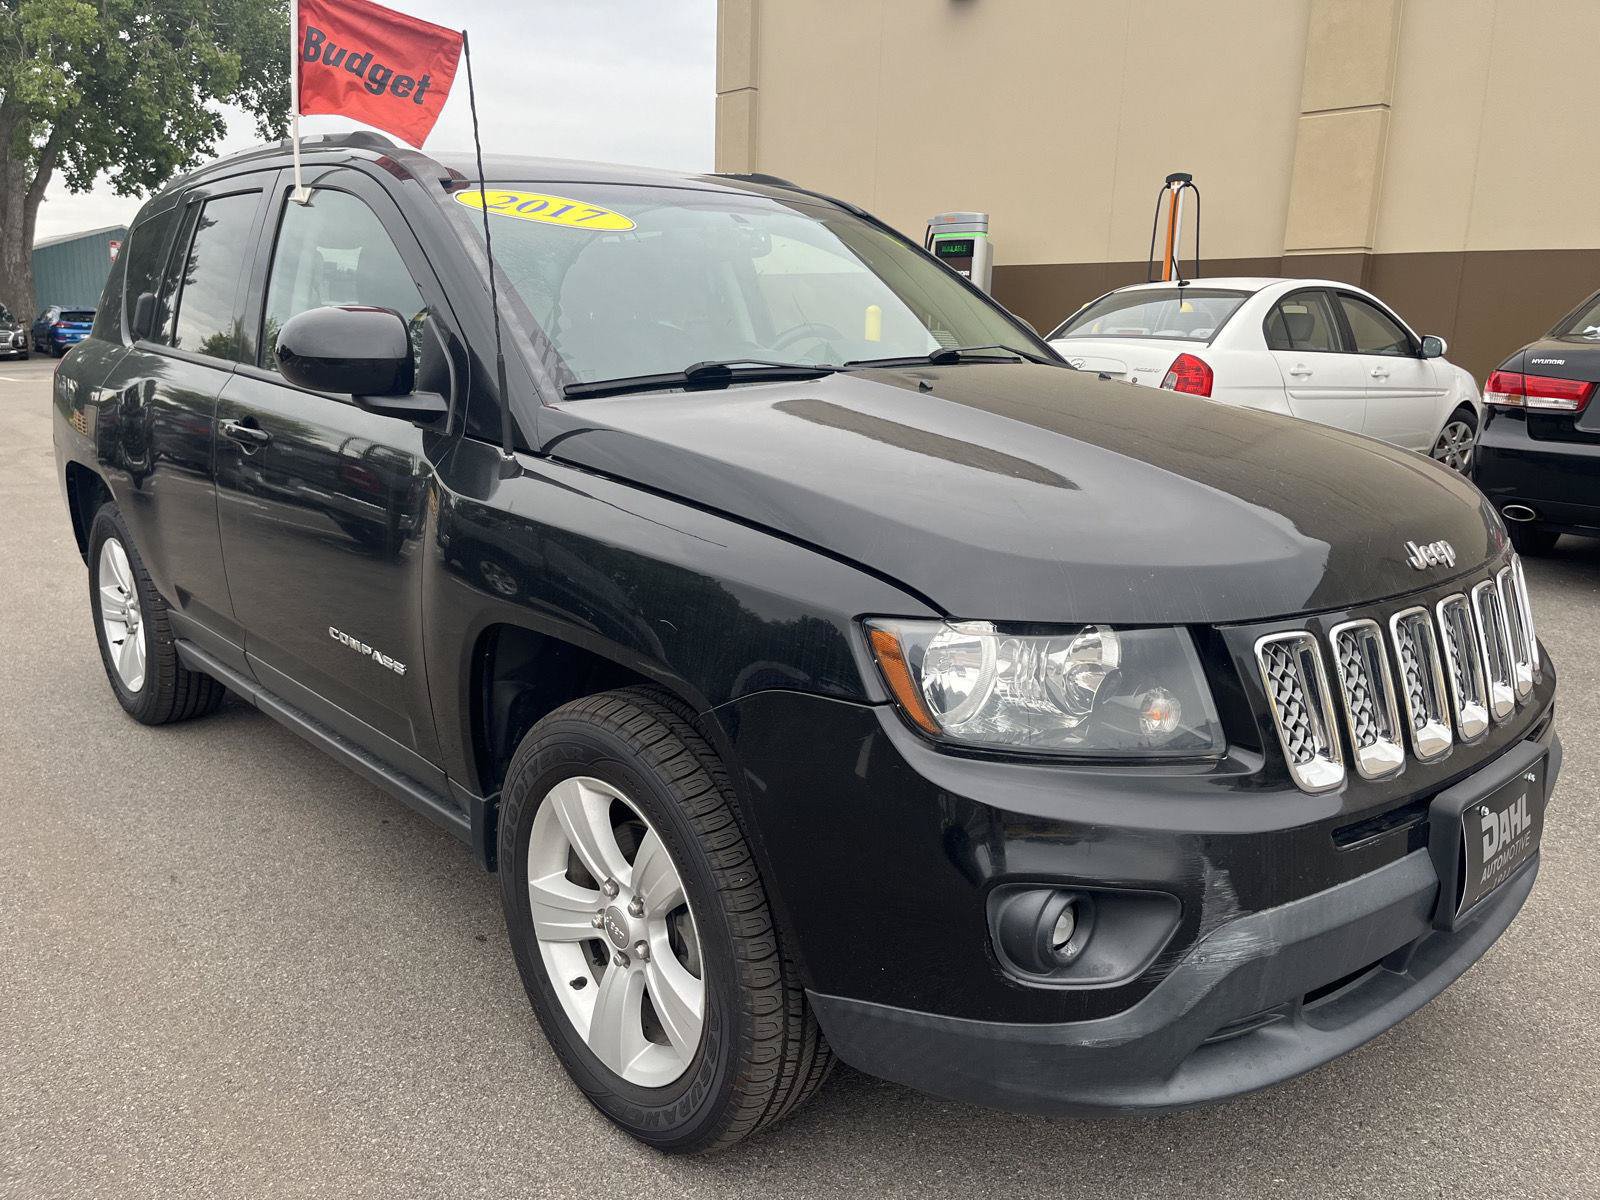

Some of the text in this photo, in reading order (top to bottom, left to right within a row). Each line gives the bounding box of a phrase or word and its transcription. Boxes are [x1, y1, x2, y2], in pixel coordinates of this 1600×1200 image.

[302, 25, 431, 106] Budget
[486, 193, 609, 224] 2017
[1531, 358, 1566, 367] HYUNDAI
[1404, 540, 1457, 570] Jeep
[328, 626, 407, 676] COMPASS
[1481, 792, 1532, 864] DAHL
[1480, 830, 1532, 885] AUTOMOTIVE
